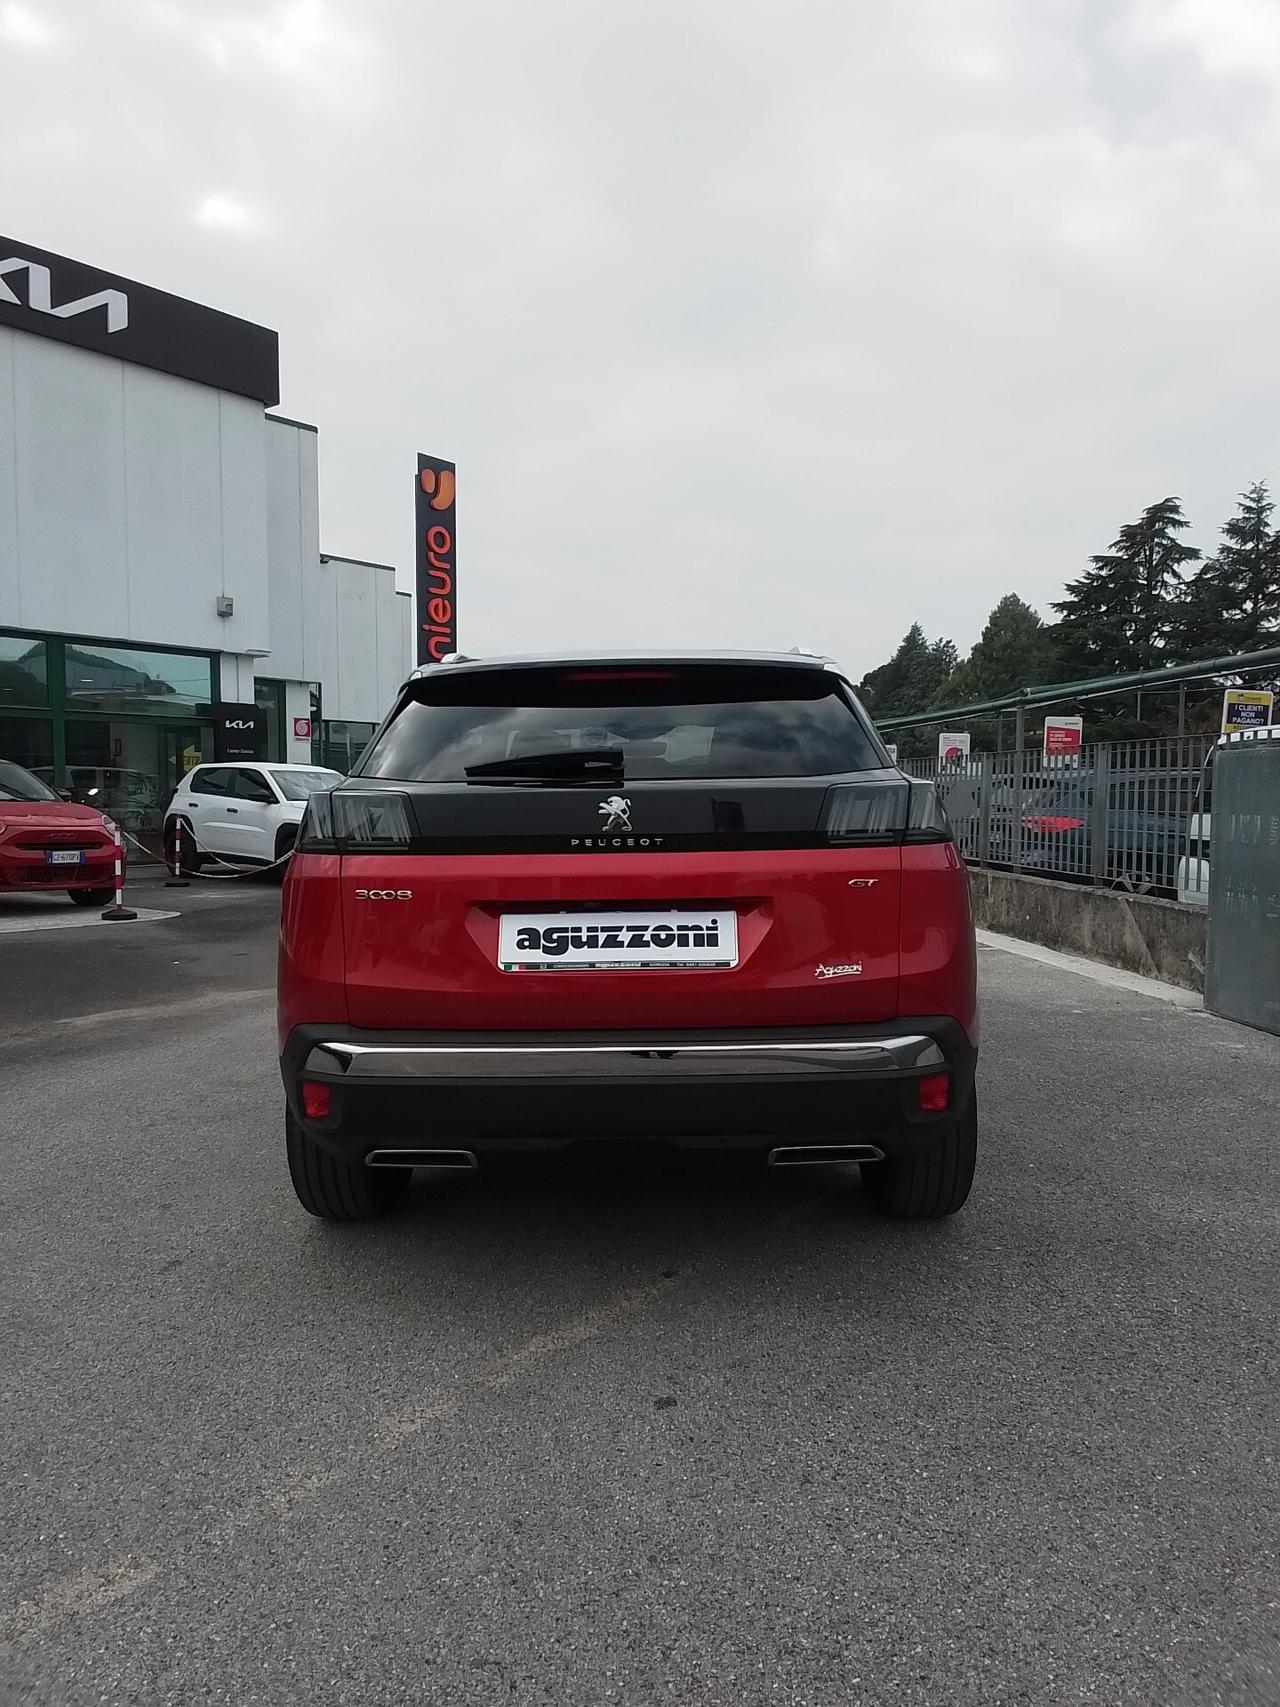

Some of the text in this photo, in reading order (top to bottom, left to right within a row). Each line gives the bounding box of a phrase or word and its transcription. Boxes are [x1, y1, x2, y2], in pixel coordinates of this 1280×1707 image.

[225, 719, 255, 729] KIA
[1232, 716, 1265, 725] PAGANO?
[571, 838, 664, 847] PEUGEOT
[848, 878, 879, 888] GT
[355, 889, 413, 900] 3008
[516, 918, 720, 956] aguzzoni
